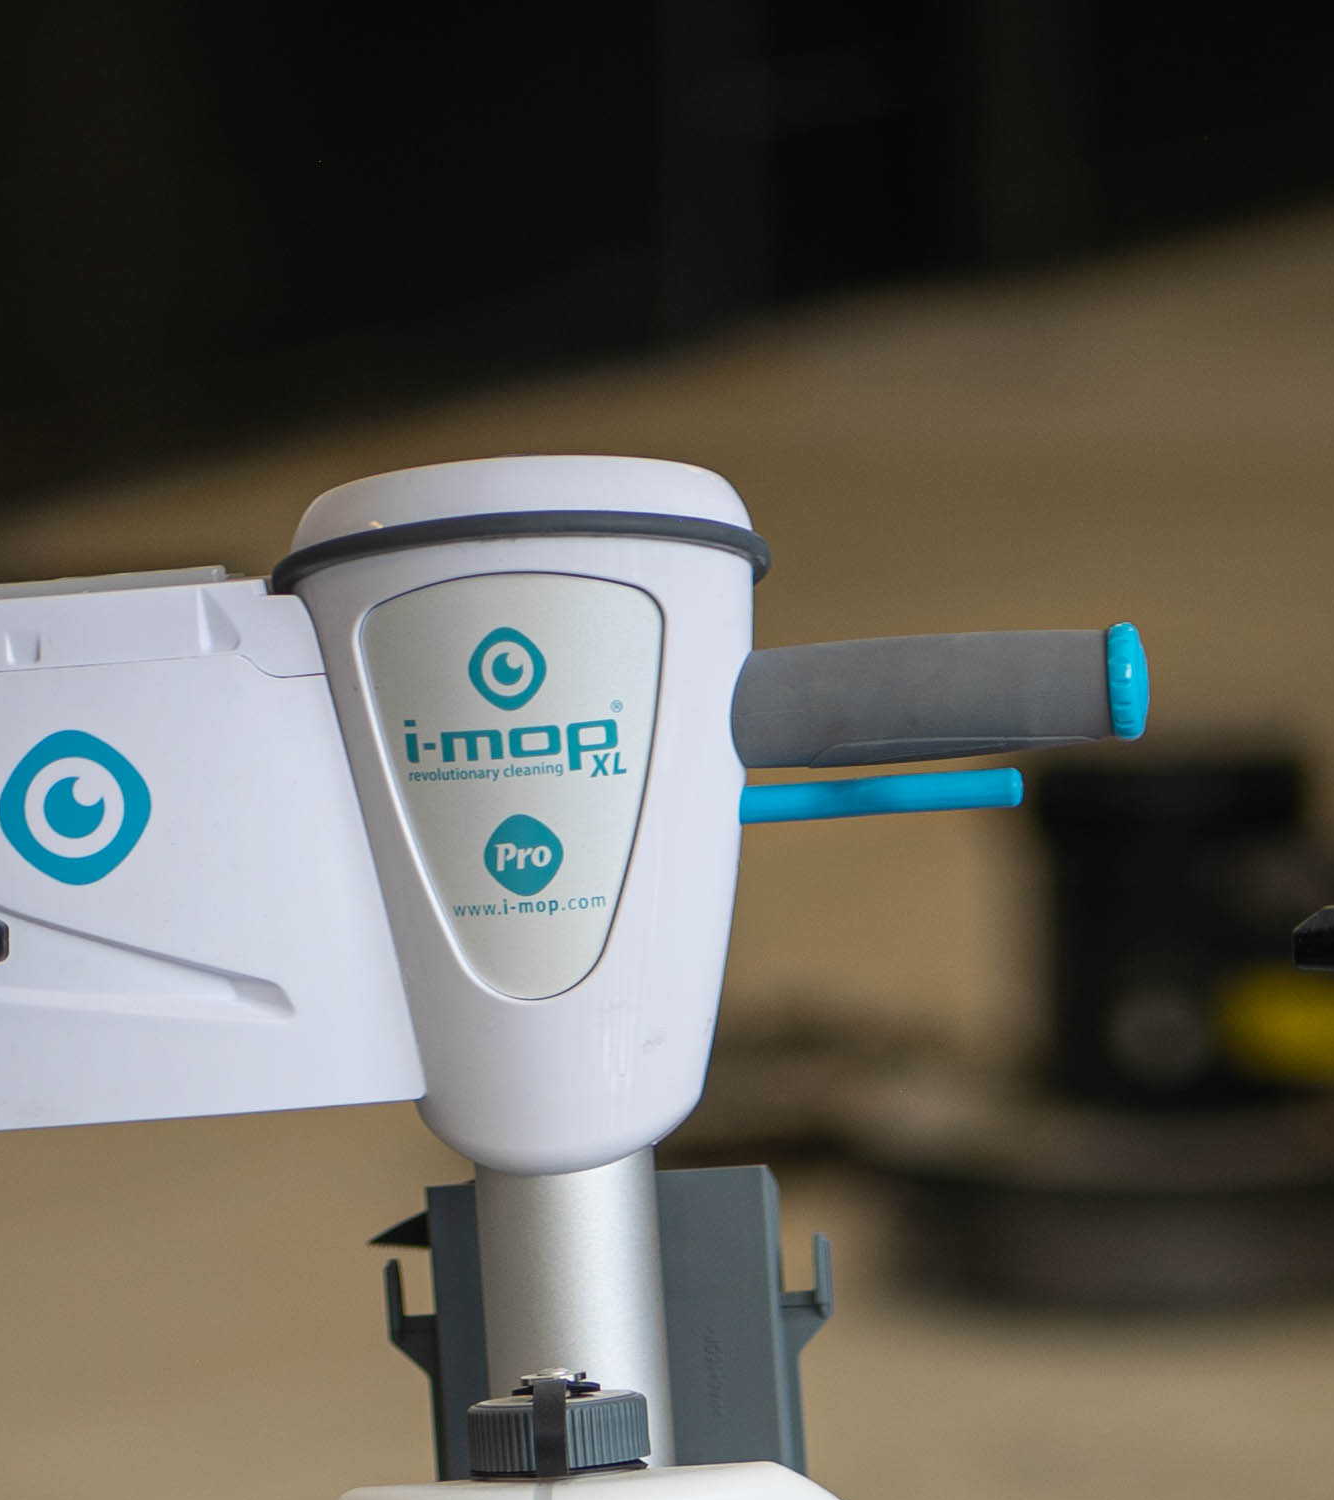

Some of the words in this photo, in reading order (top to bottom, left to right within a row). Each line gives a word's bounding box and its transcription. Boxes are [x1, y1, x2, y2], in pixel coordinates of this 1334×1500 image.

[408, 767, 500, 782] revolutionary
[503, 761, 564, 778] cleaning
[590, 751, 627, 778] XL
[494, 842, 553, 872] Pro
[452, 895, 607, 916] www.i-mop.com
